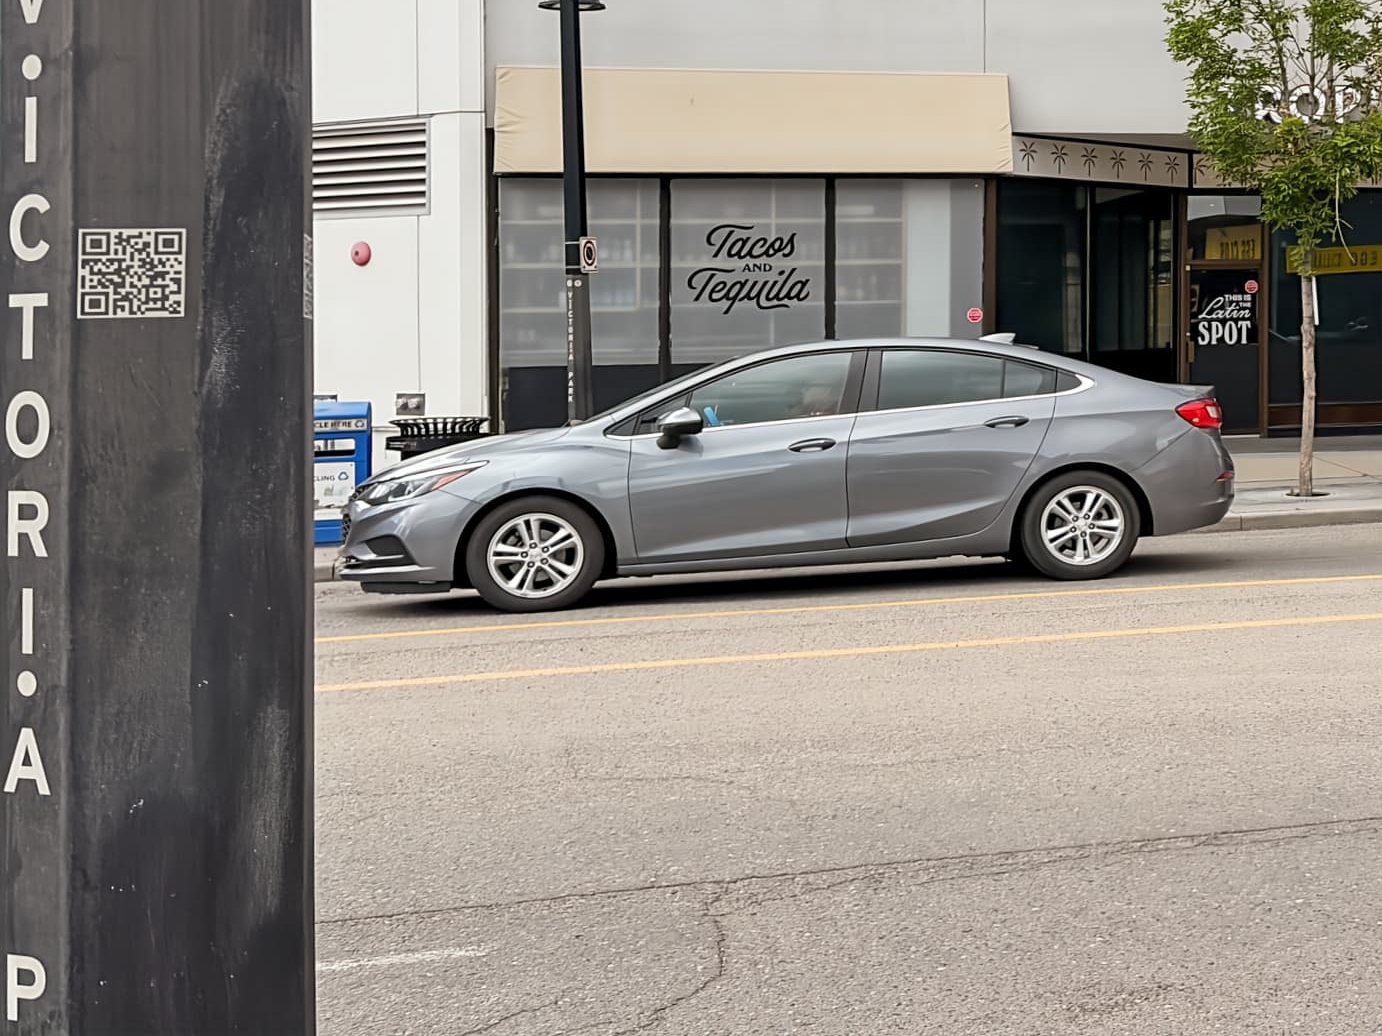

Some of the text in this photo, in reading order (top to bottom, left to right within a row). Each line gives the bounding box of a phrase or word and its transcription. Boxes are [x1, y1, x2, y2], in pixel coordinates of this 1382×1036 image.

[706, 224, 797, 260] Tacos
[742, 263, 773, 272] AND
[687, 267, 811, 315] Tequila
[1198, 297, 1251, 319] Latin
[1197, 320, 1252, 345] SPOT
